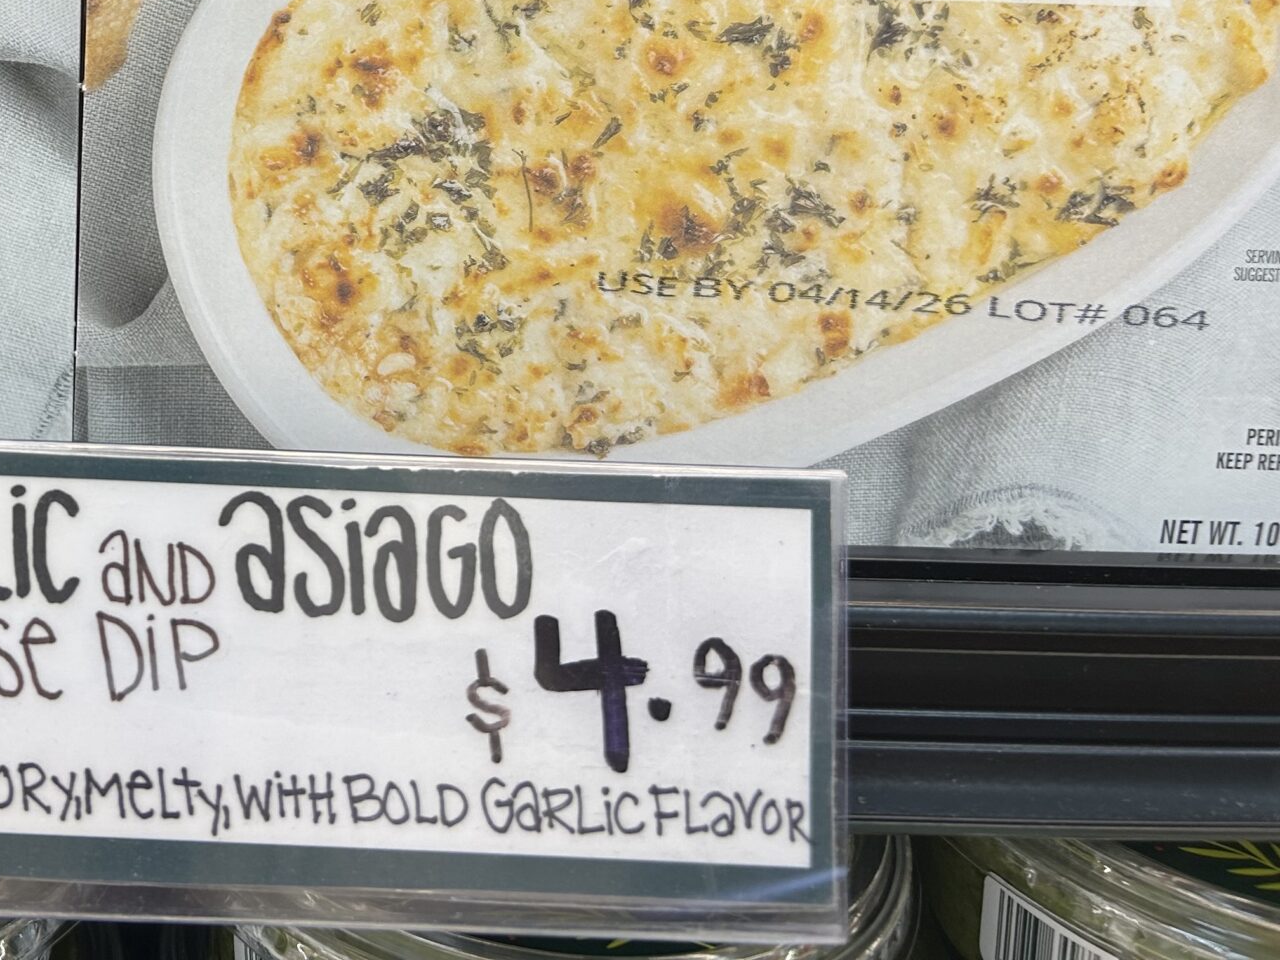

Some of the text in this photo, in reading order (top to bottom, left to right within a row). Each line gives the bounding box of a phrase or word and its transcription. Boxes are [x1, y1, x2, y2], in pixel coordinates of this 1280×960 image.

[1244, 248, 1280, 264] SERVIN
[1232, 266, 1280, 282] SUGGEST
[597, 270, 1210, 331] USE BY 04/14/26 LOT# 064
[1216, 451, 1254, 470] KEEP
[1159, 518, 1280, 547] NET WT. 10
[341, 772, 470, 827] BOLD
